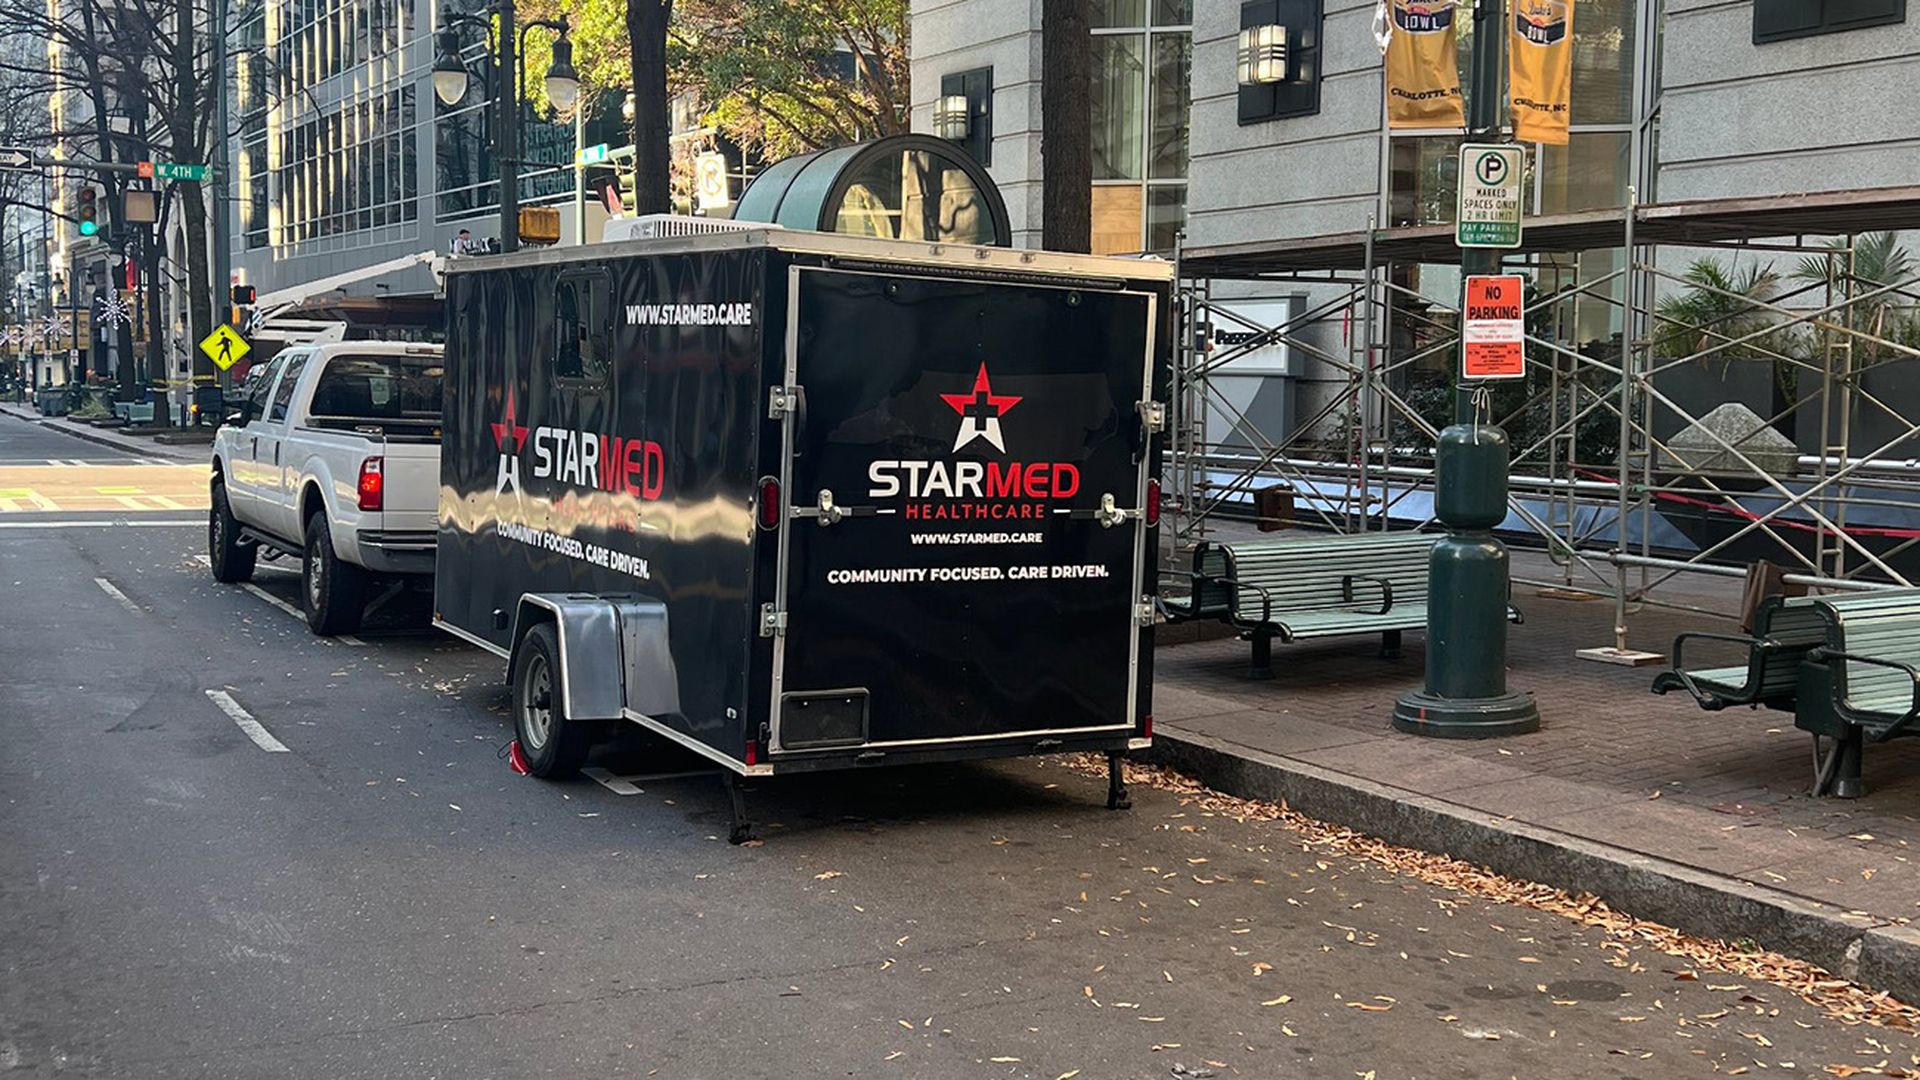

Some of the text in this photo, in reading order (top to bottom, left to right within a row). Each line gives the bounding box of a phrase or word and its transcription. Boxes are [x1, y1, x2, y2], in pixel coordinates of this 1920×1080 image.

[157, 165, 192, 178] W. 4TH
[1485, 157, 1502, 179] P
[1476, 188, 1507, 198] MARKED
[1464, 199, 1517, 209] SPACES ONLY
[1467, 210, 1472, 220] 2
[1490, 211, 1512, 220] LIMIT
[1461, 223, 1517, 233] PAY PARKING
[1485, 286, 1502, 300] NO
[626, 303, 751, 325] WWW.STARMED.CARE
[1469, 306, 1518, 320] PARKING
[534, 426, 664, 501] STARMED
[868, 460, 1080, 498] STARMED
[905, 504, 1045, 519] HEALTHCARE
[911, 532, 1043, 545] WWW.STARMED.CARE
[497, 520, 650, 580] COMMUNITY FOCUSED. CARE DRIVEN.
[827, 564, 1109, 584] COMMUNITY FOCUSED. CARE DRIVEN.
